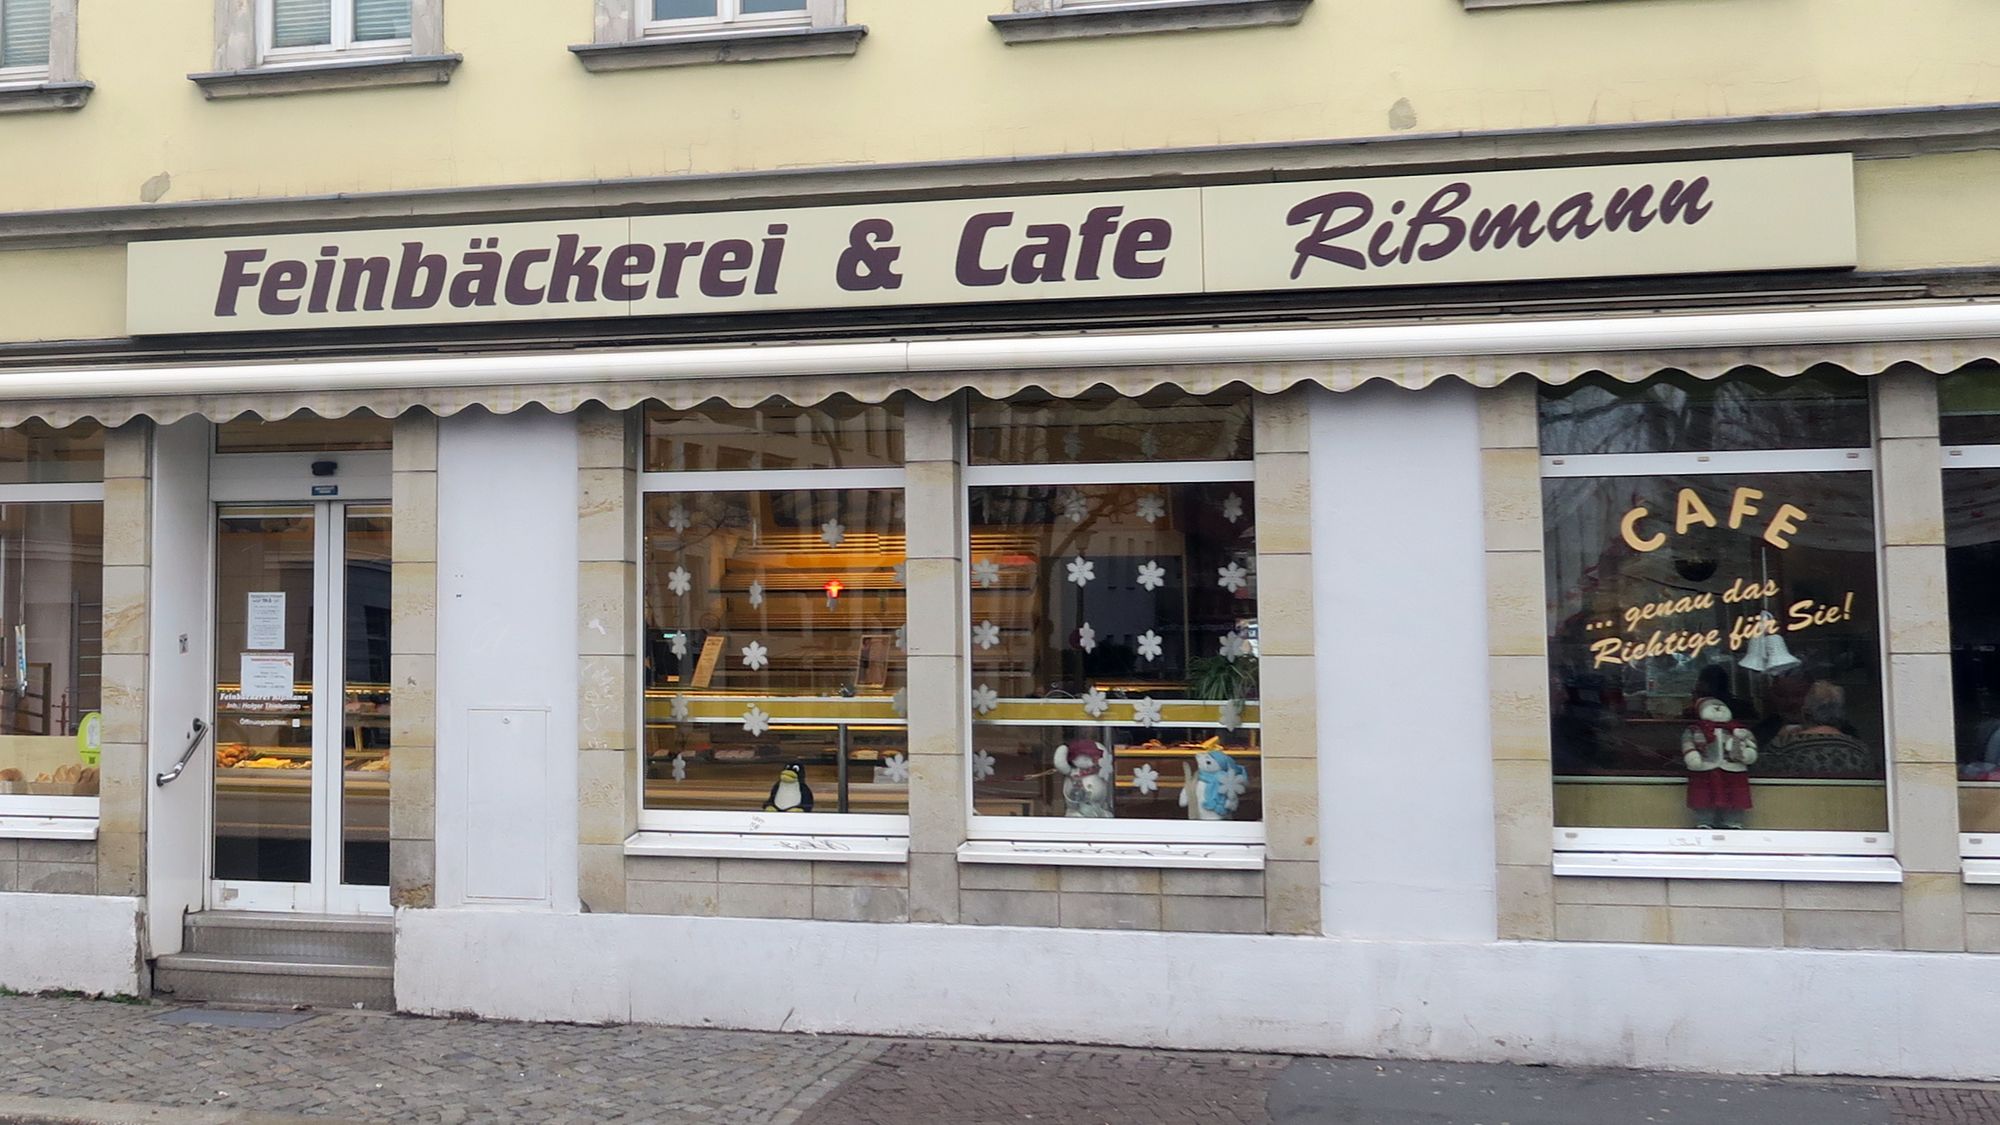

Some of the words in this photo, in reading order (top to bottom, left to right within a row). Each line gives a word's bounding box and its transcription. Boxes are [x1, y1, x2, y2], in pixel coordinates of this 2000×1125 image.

[214, 223, 788, 317] Feinbäckerei
[835, 218, 903, 292] &
[955, 205, 1172, 287] Cafe
[1286, 176, 1713, 280] Rißmann
[1620, 487, 1807, 552] CAFE
[1721, 577, 1780, 604] das
[1590, 625, 1721, 669] Richtige
[1729, 613, 1780, 651] für
[1787, 591, 1855, 632] Sie!
